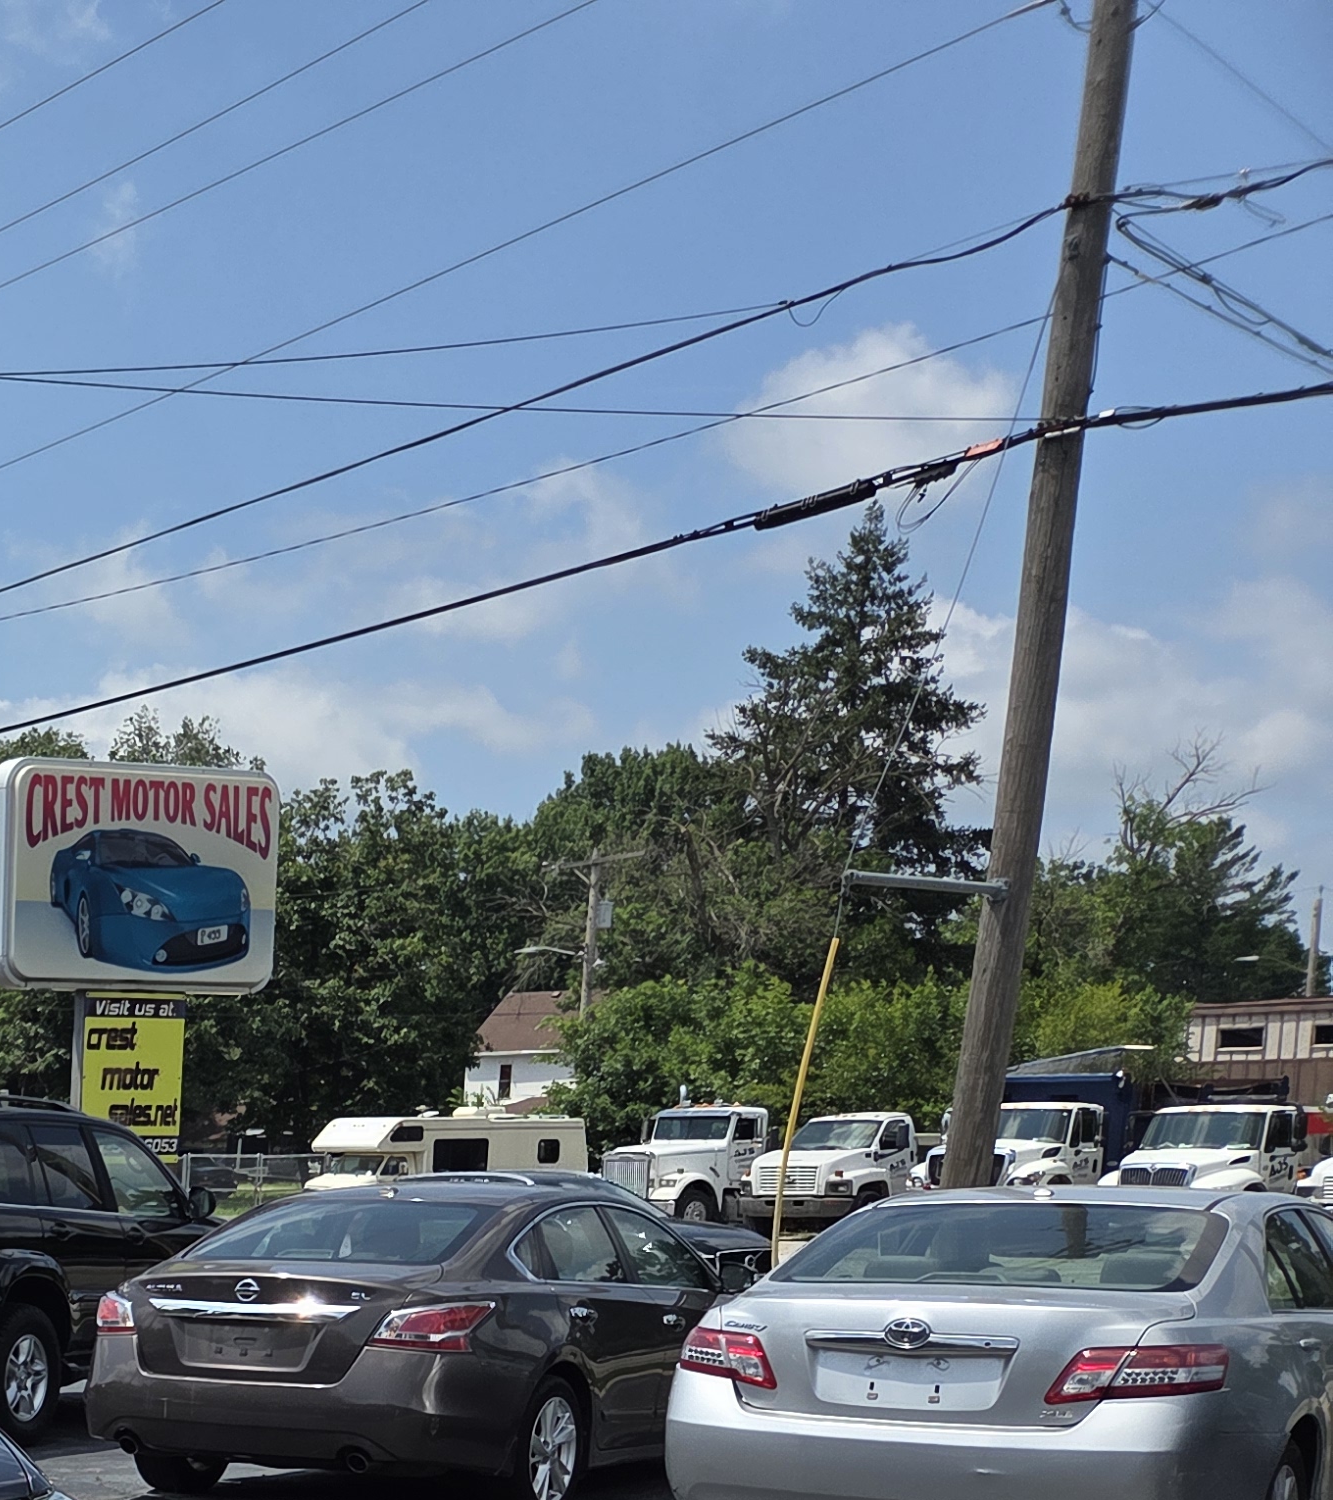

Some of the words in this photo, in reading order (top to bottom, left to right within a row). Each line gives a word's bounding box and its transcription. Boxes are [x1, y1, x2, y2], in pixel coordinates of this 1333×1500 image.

[26, 773, 105, 848] CREST
[110, 778, 196, 827] MOTOR
[203, 782, 272, 860] SALES
[96, 1000, 131, 1016] Visit
[134, 1003, 156, 1017] us
[86, 1021, 138, 1051] crest
[101, 1061, 160, 1091] motor
